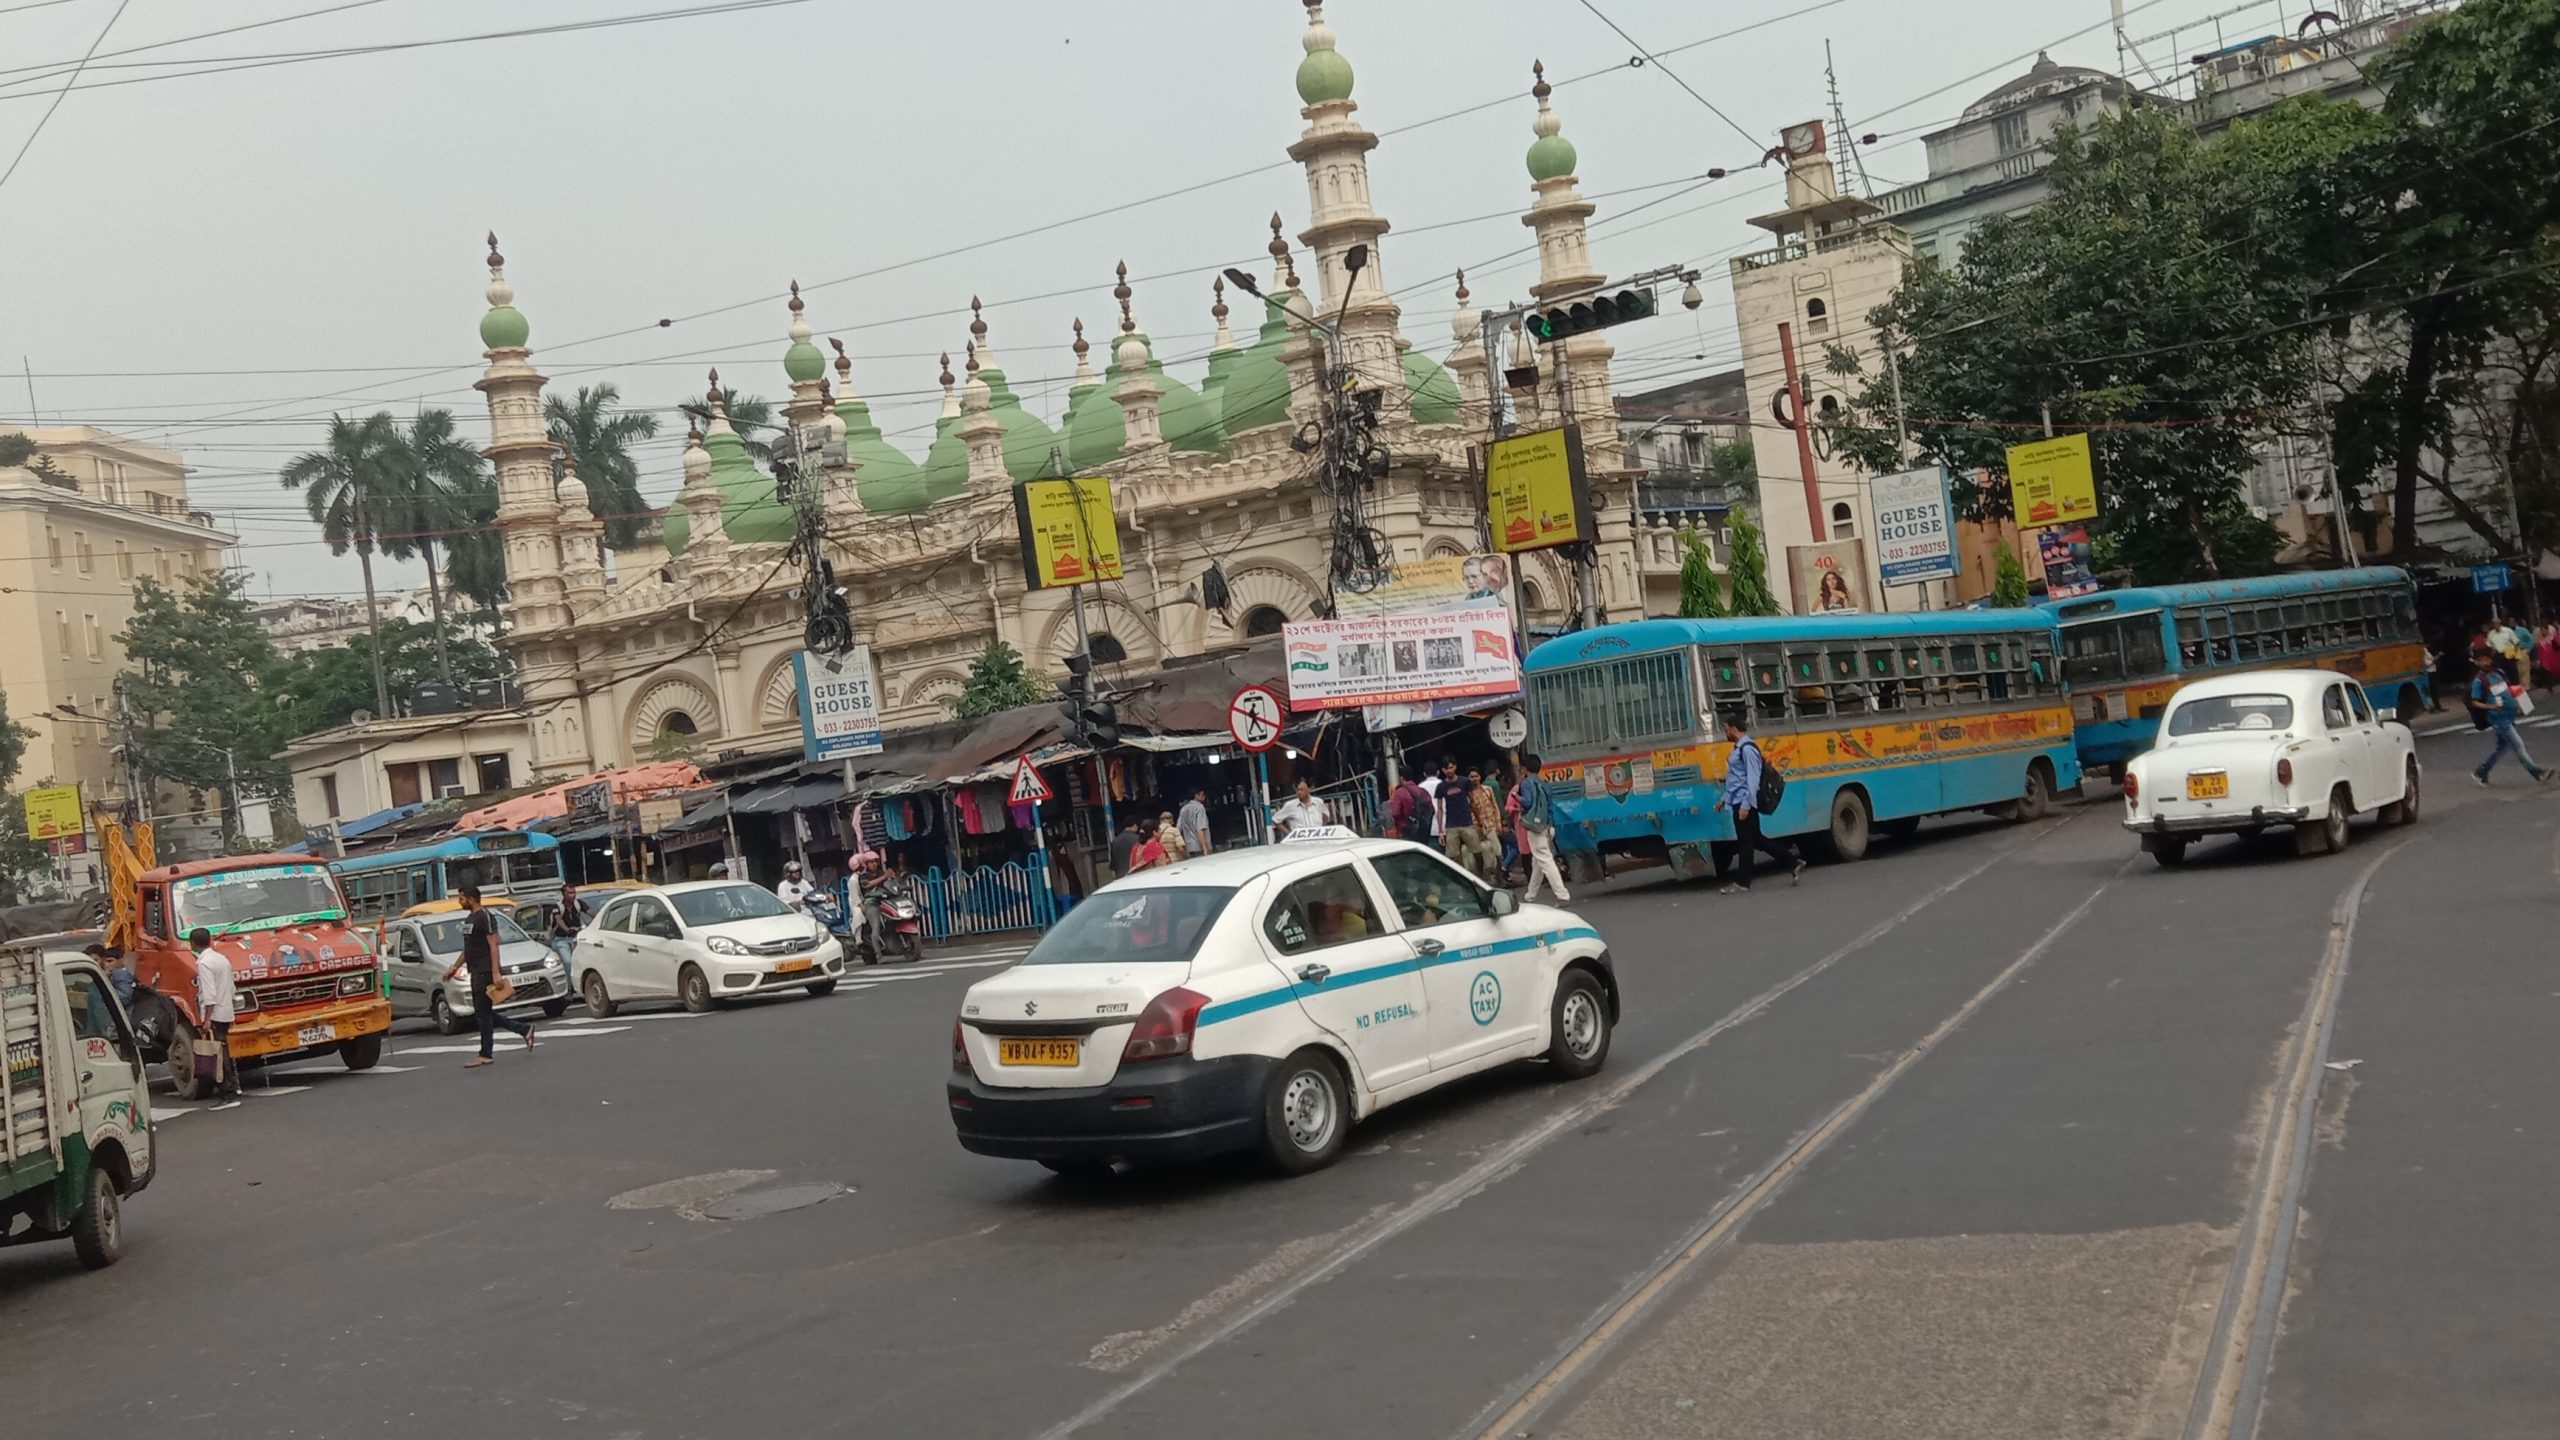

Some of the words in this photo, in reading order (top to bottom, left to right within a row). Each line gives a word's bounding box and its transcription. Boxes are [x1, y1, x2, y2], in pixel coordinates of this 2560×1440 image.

[1880, 504, 1940, 525] GUEST
[1880, 519, 1942, 541] HOUSE
[1889, 548, 1904, 560] 033
[1910, 540, 1948, 556] 22303755
[1814, 556, 1833, 568] 40
[814, 680, 870, 698] GUEST
[814, 696, 872, 714] HOUSE
[824, 722, 838, 734] 033
[842, 717, 878, 732] 22303755
[1504, 719, 1510, 730] 1
[1544, 768, 1574, 782] STOP
[280, 964, 304, 974] TATA
[1479, 982, 1492, 996] AC
[1474, 997, 1496, 1014] TAXI
[1356, 1014, 1370, 1029] NO
[1374, 1002, 1415, 1024] REFUSAL
[1008, 1044, 1020, 1060] WB
[1024, 1044, 1036, 1060] 04
[1040, 1044, 1046, 1060] F
[1049, 1044, 1076, 1060] 9357
